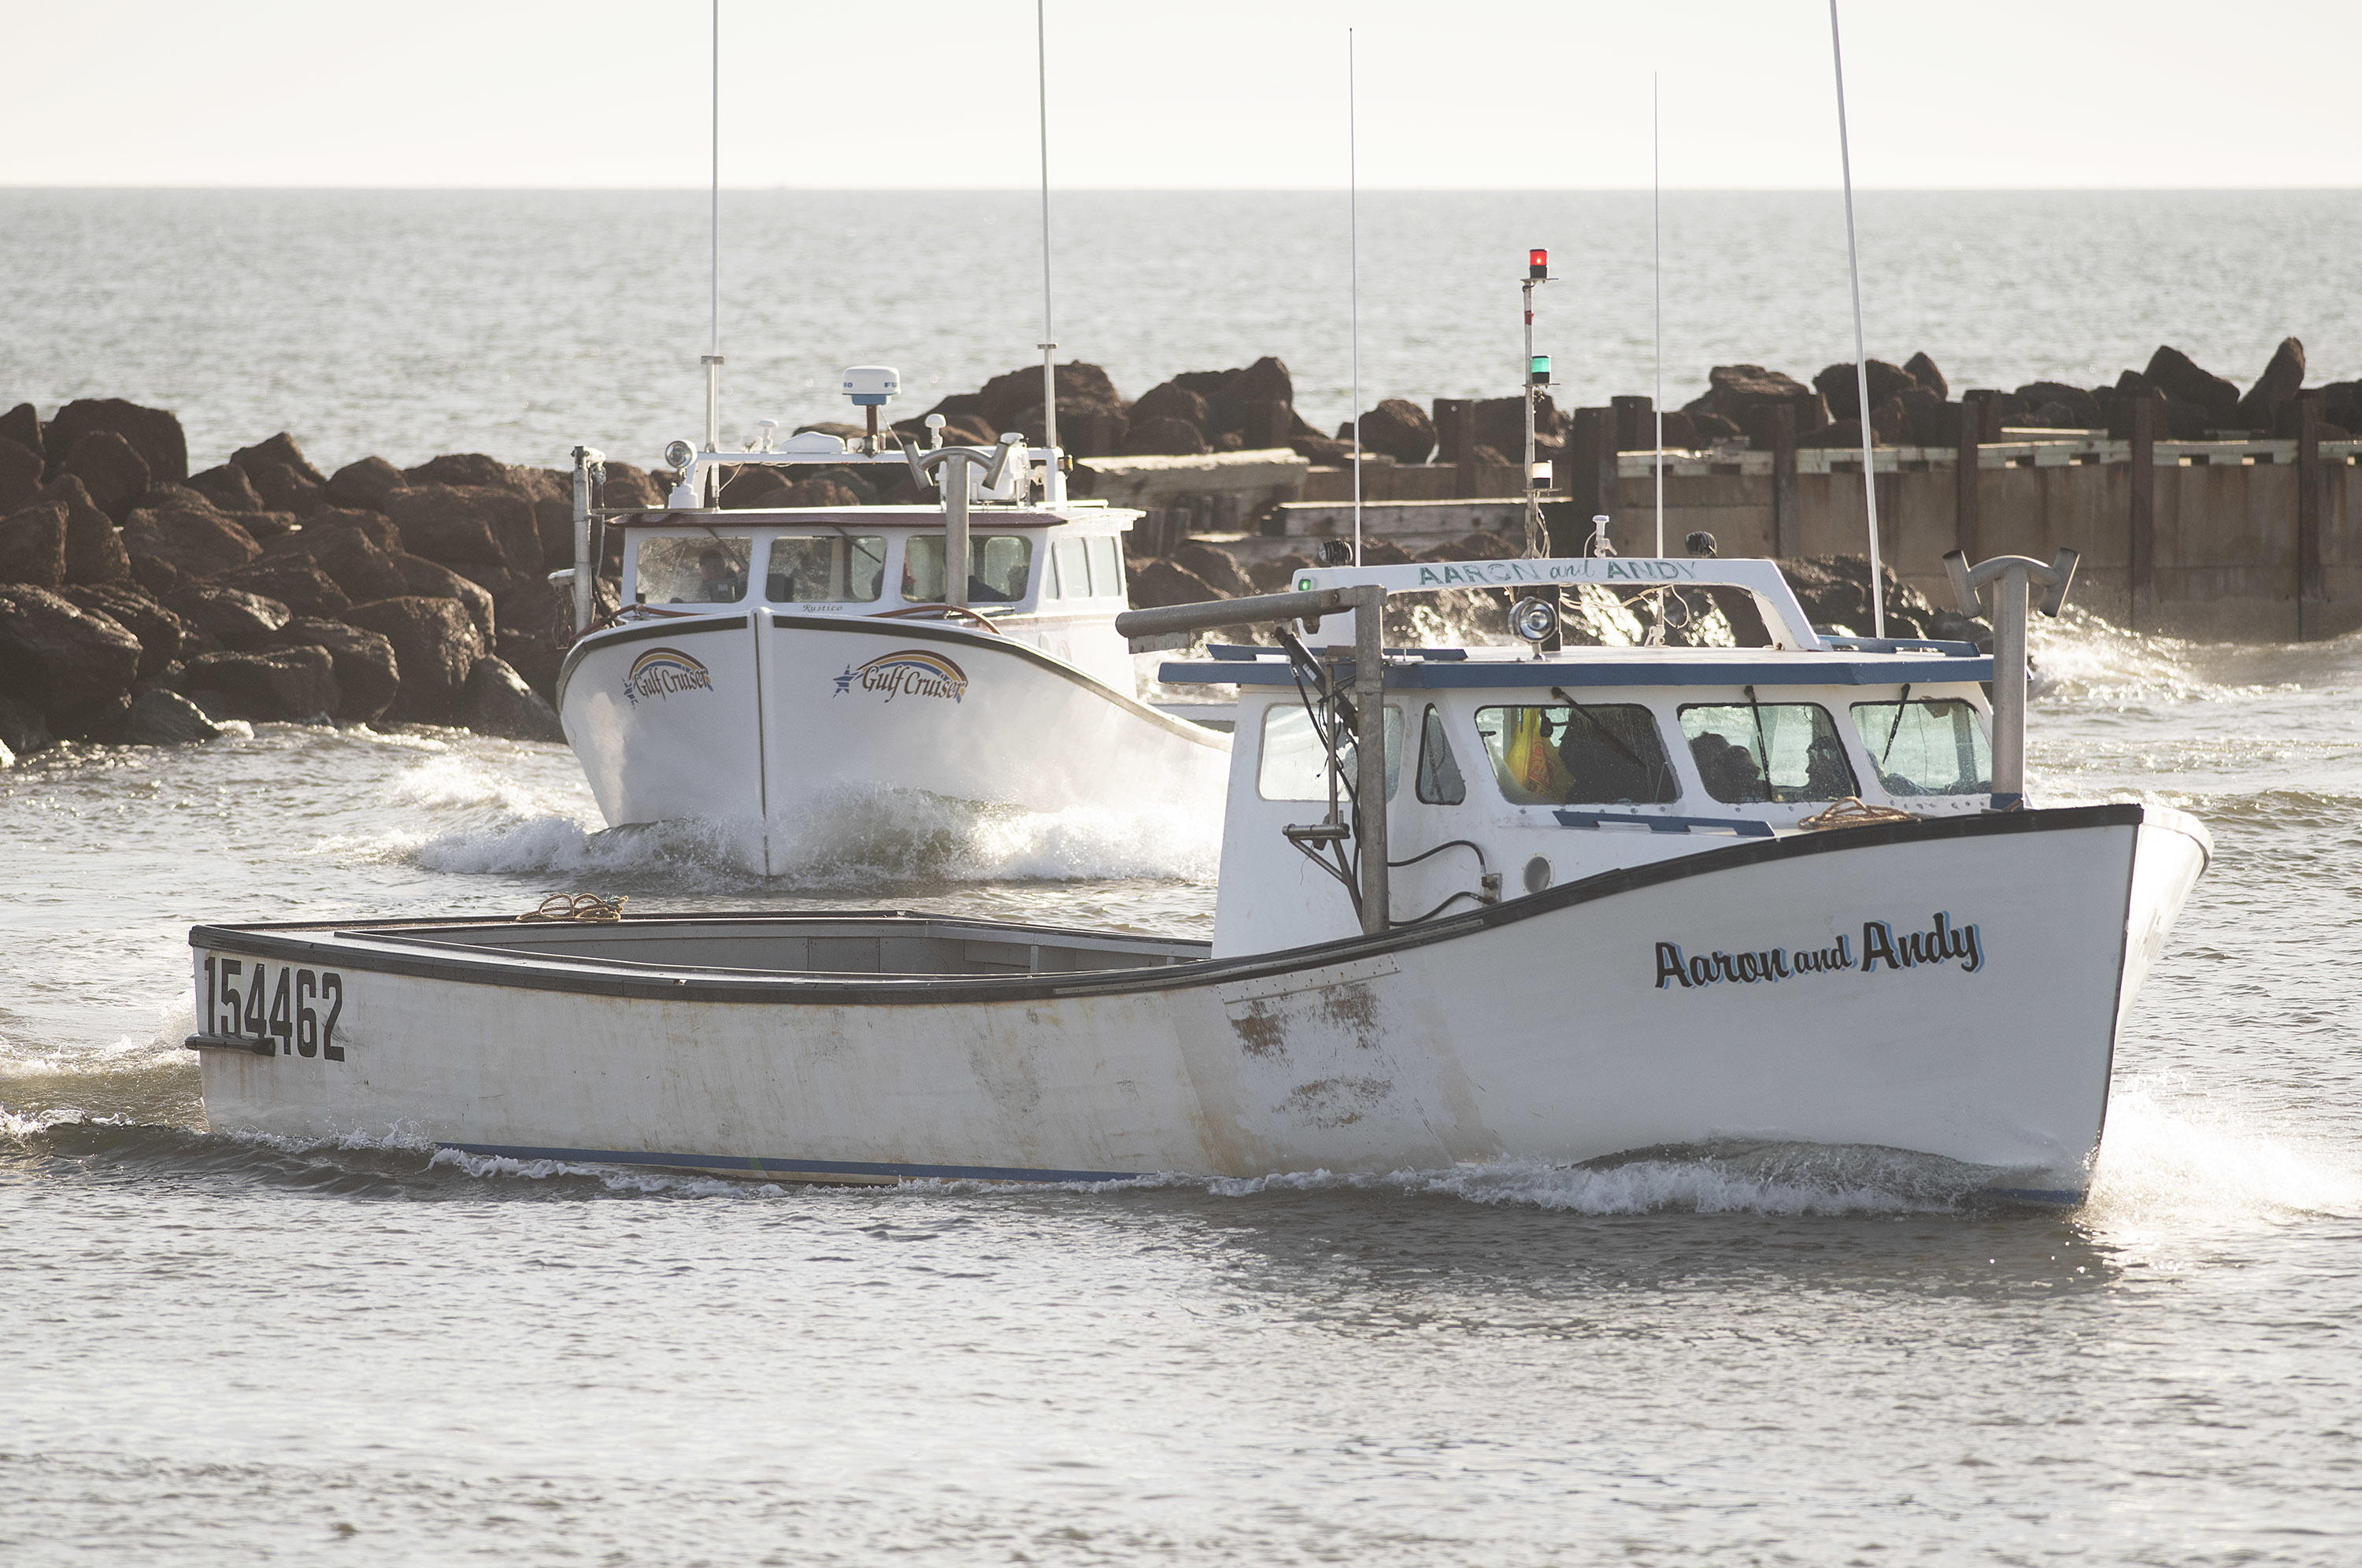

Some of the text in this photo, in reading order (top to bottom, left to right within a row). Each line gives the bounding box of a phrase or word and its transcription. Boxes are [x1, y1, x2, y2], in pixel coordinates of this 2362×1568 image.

[1419, 560, 1696, 585] AARON and ANDY
[802, 604, 843, 612] Rustico
[634, 666, 708, 701] Gulf Cruiser
[862, 664, 968, 703] Gulf Cruiser
[1655, 911, 1984, 989] Aaron and Andy
[204, 956, 345, 1062] 154462
